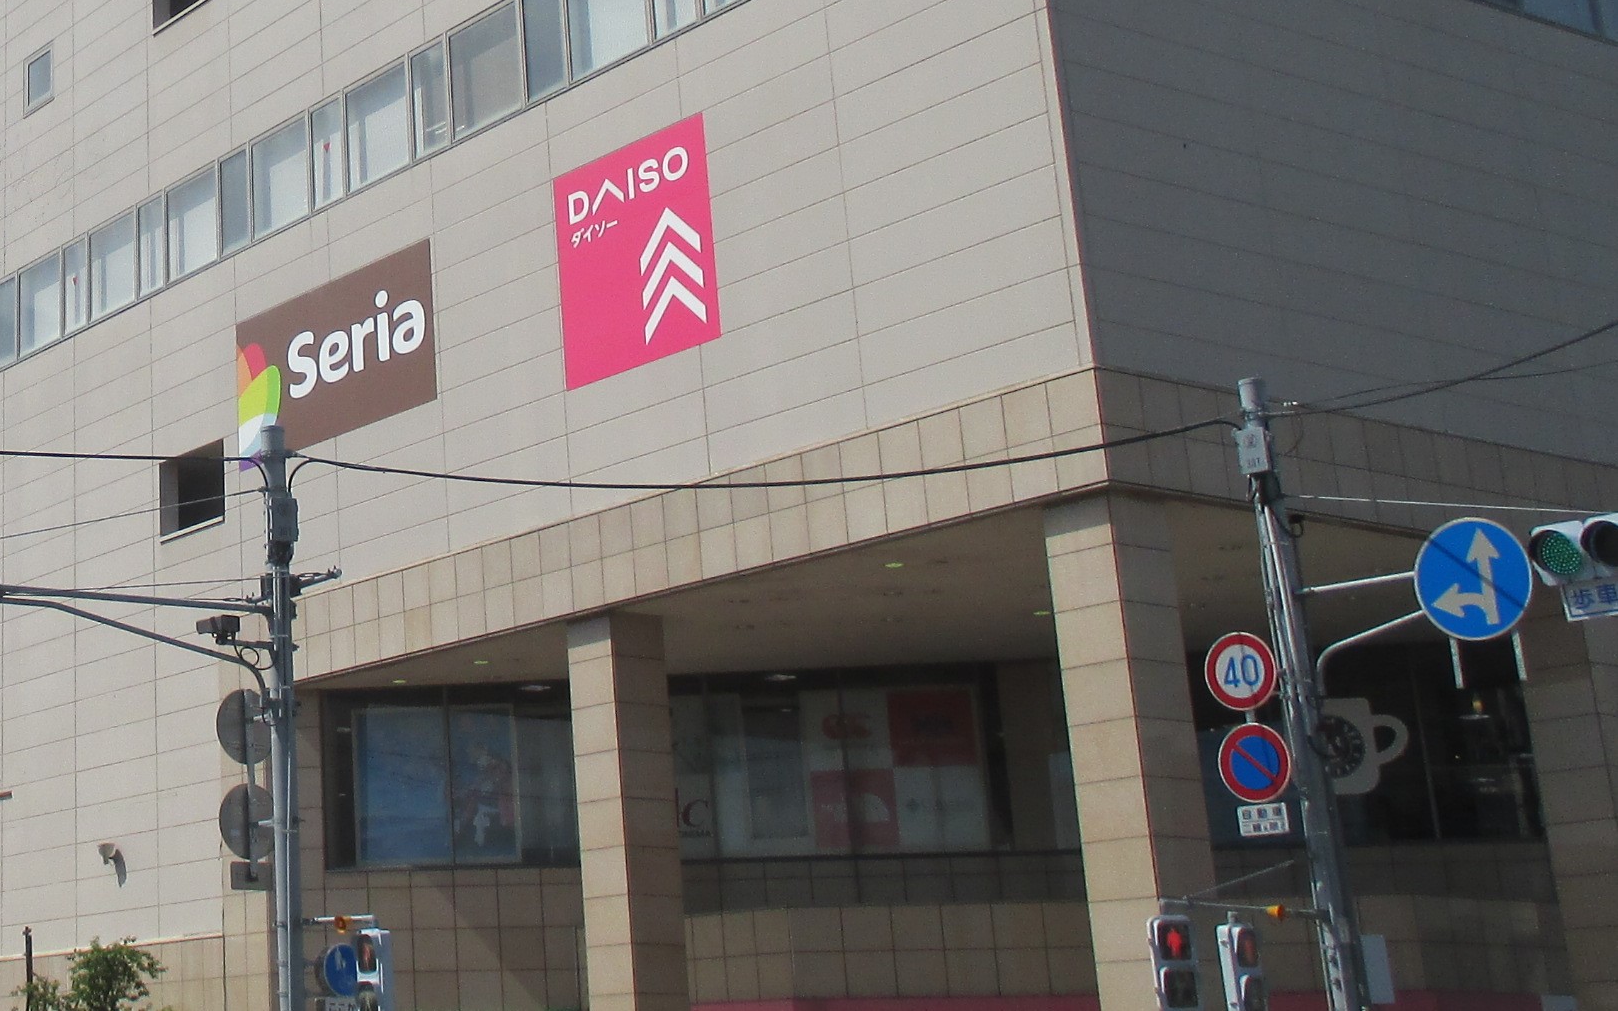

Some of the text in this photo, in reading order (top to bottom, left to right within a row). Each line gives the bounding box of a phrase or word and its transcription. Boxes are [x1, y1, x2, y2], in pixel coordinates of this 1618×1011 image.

[570, 219, 619, 248] ダイソー
[288, 290, 426, 399] Seria
[1223, 653, 1260, 688] 40
